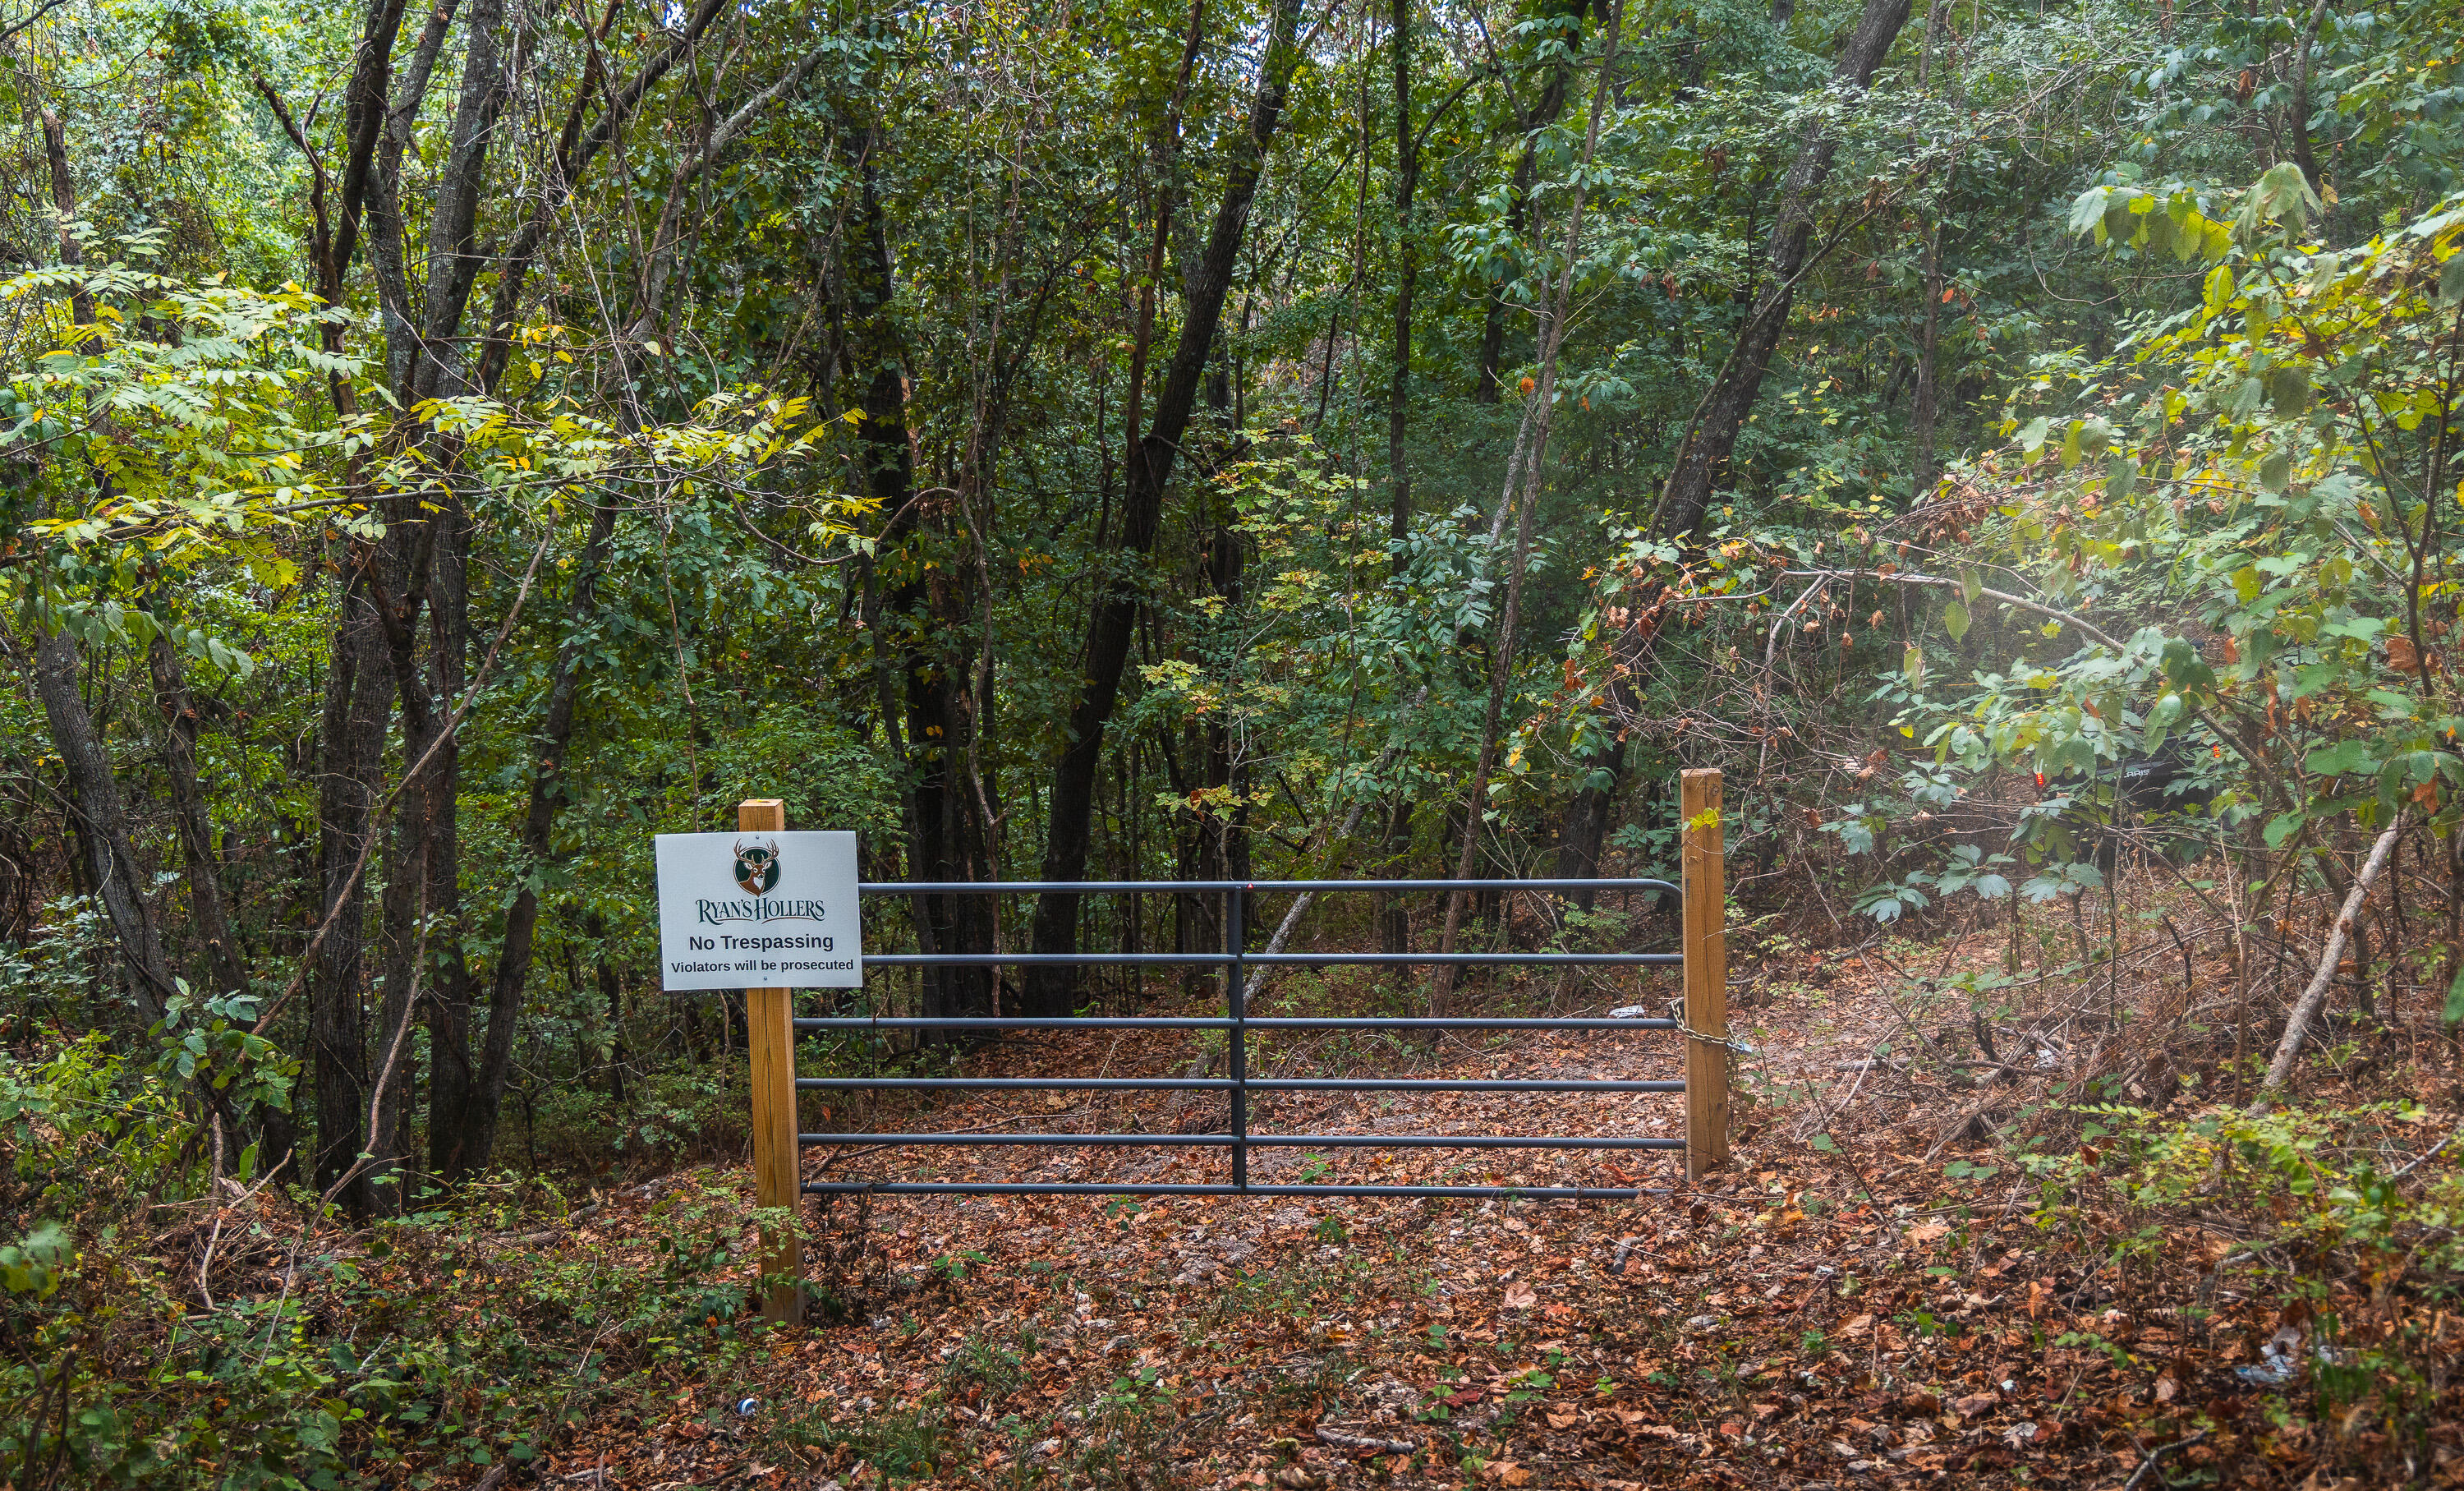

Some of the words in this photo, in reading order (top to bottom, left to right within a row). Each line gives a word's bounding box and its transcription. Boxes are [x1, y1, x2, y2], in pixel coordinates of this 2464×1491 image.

[696, 899, 753, 926] RYAN'S
[754, 896, 825, 923] HOLLERS
[689, 936, 716, 950] No
[719, 934, 834, 952] Trespassing
[670, 961, 731, 973] Violators
[733, 959, 756, 971] will
[761, 959, 777, 971] be
[780, 959, 854, 973] prosecuted
